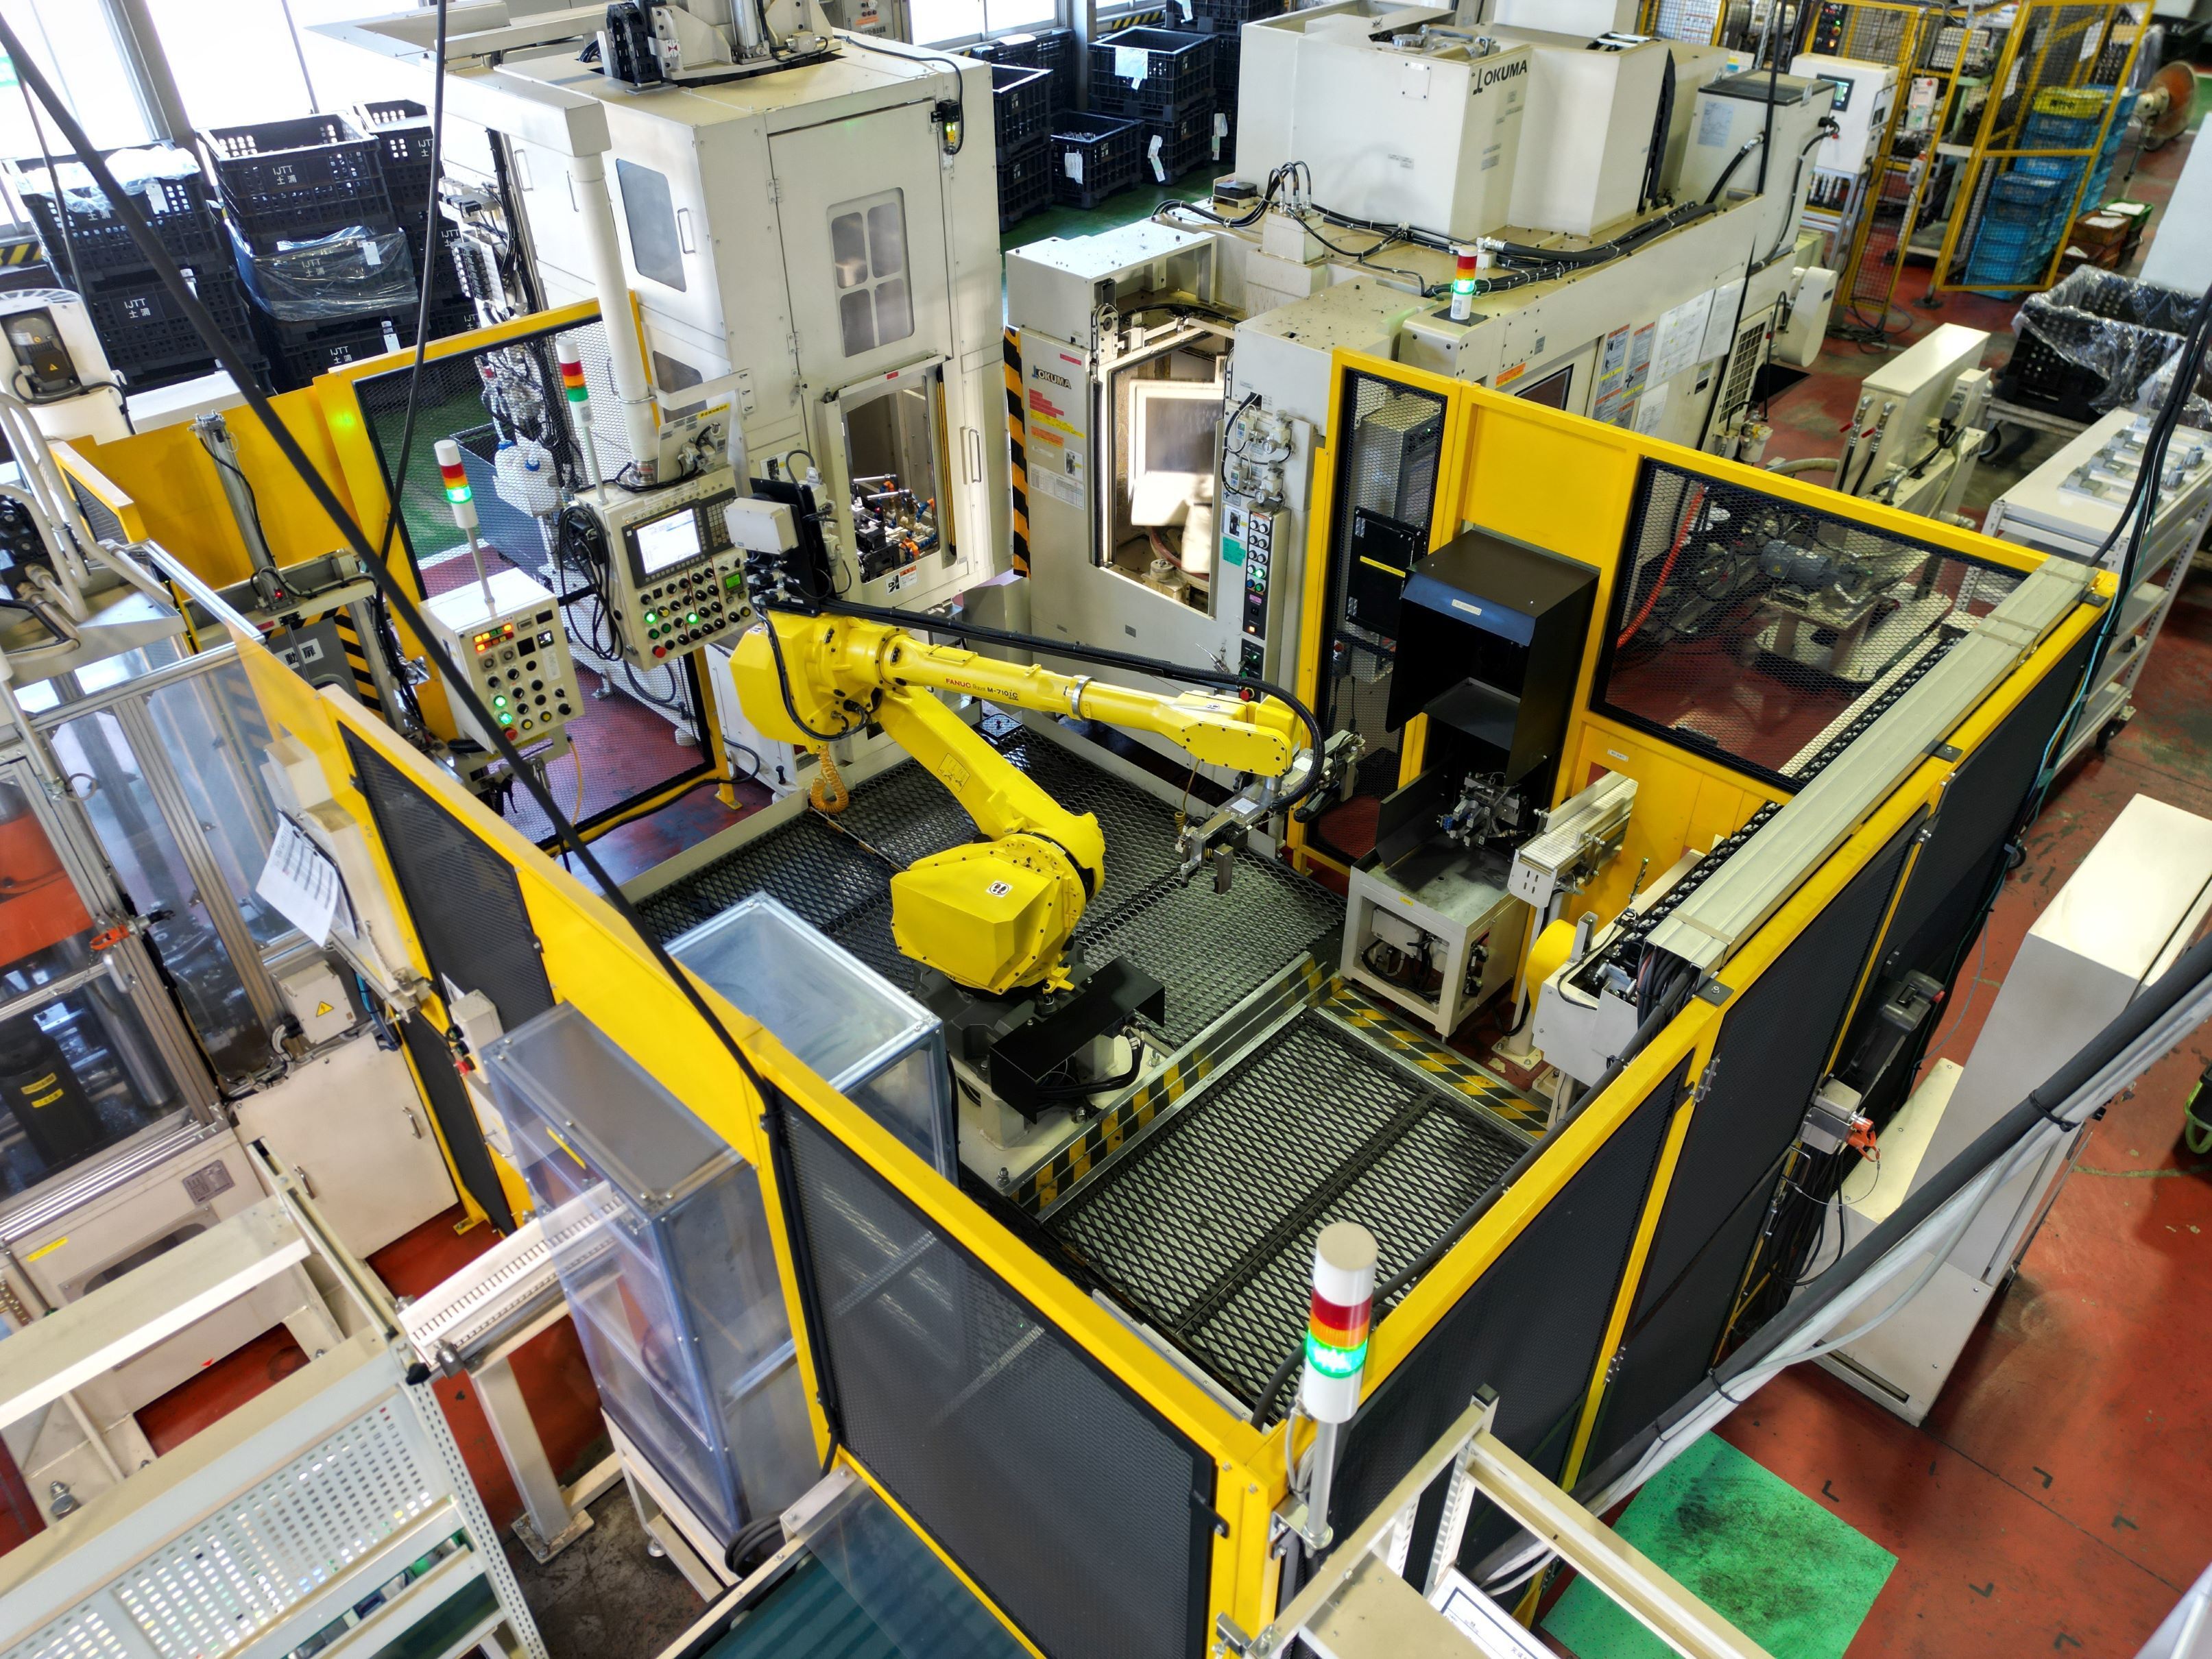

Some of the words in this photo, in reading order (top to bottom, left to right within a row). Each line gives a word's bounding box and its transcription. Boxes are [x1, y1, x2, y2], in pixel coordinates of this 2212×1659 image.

[1484, 60, 1528, 86] OKUMA
[418, 138, 433, 147] IJT
[272, 165, 293, 175] IJTT
[276, 174, 297, 185] 土浦
[441, 229, 459, 239] IJTT
[302, 258, 322, 268] IJTT
[123, 298, 147, 309] IJTT
[129, 307, 151, 319] 土浦
[464, 313, 478, 322] IJT
[329, 345, 349, 356] IJTT
[1037, 369, 1072, 389] OKUMA
[946, 678, 972, 688] FANUC
